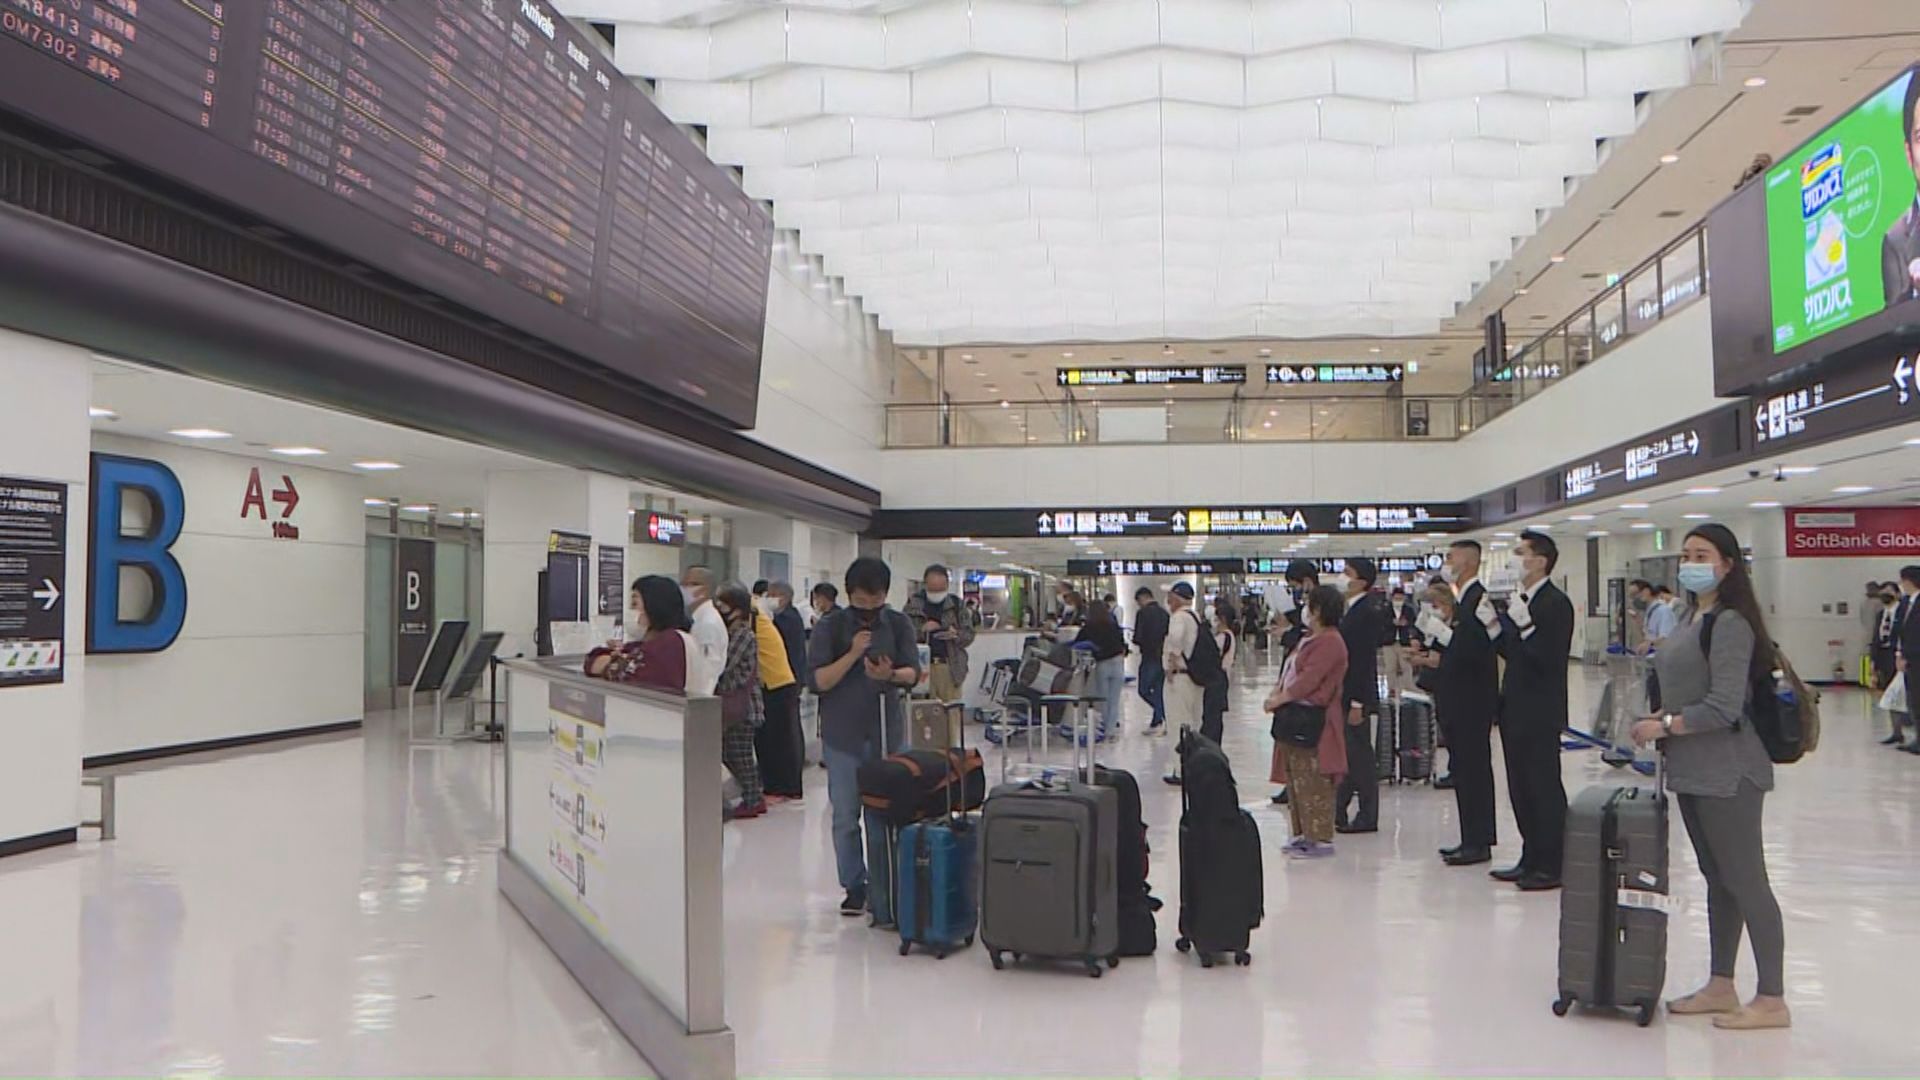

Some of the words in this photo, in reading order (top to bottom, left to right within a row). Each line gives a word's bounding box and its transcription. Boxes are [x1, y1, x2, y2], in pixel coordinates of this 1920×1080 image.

[3, 12, 77, 60] OM7302
[521, 0, 555, 40] Arrivals
[1804, 279, 1853, 325] サロンパス
[241, 467, 267, 520] A
[1289, 509, 1308, 530] A
[86, 452, 188, 654] B
[1794, 533, 1872, 549] SoftBank
[1158, 563, 1181, 574] Train
[406, 571, 420, 611] B
